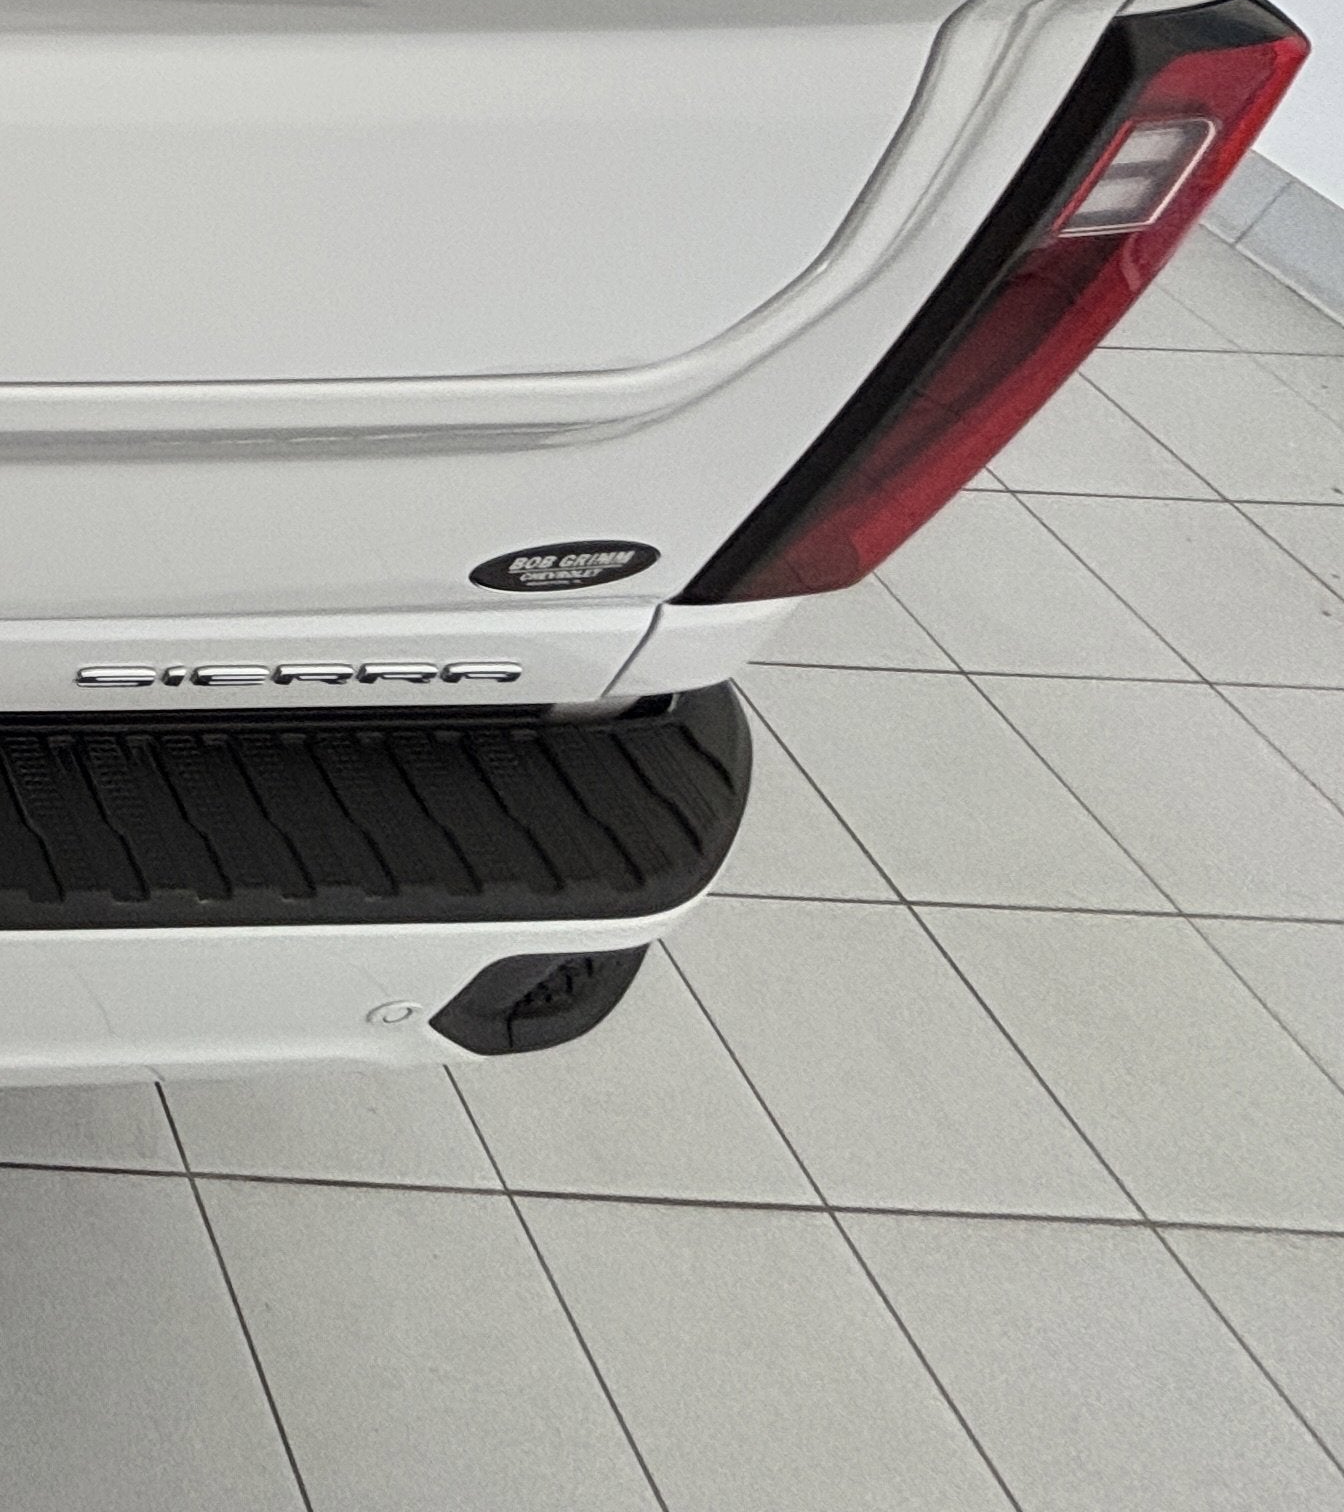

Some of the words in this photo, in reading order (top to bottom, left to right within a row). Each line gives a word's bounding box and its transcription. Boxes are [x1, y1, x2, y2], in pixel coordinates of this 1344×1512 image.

[509, 555, 558, 571] BOB
[558, 550, 636, 568] GRIMM
[75, 662, 523, 688] SIERRA
